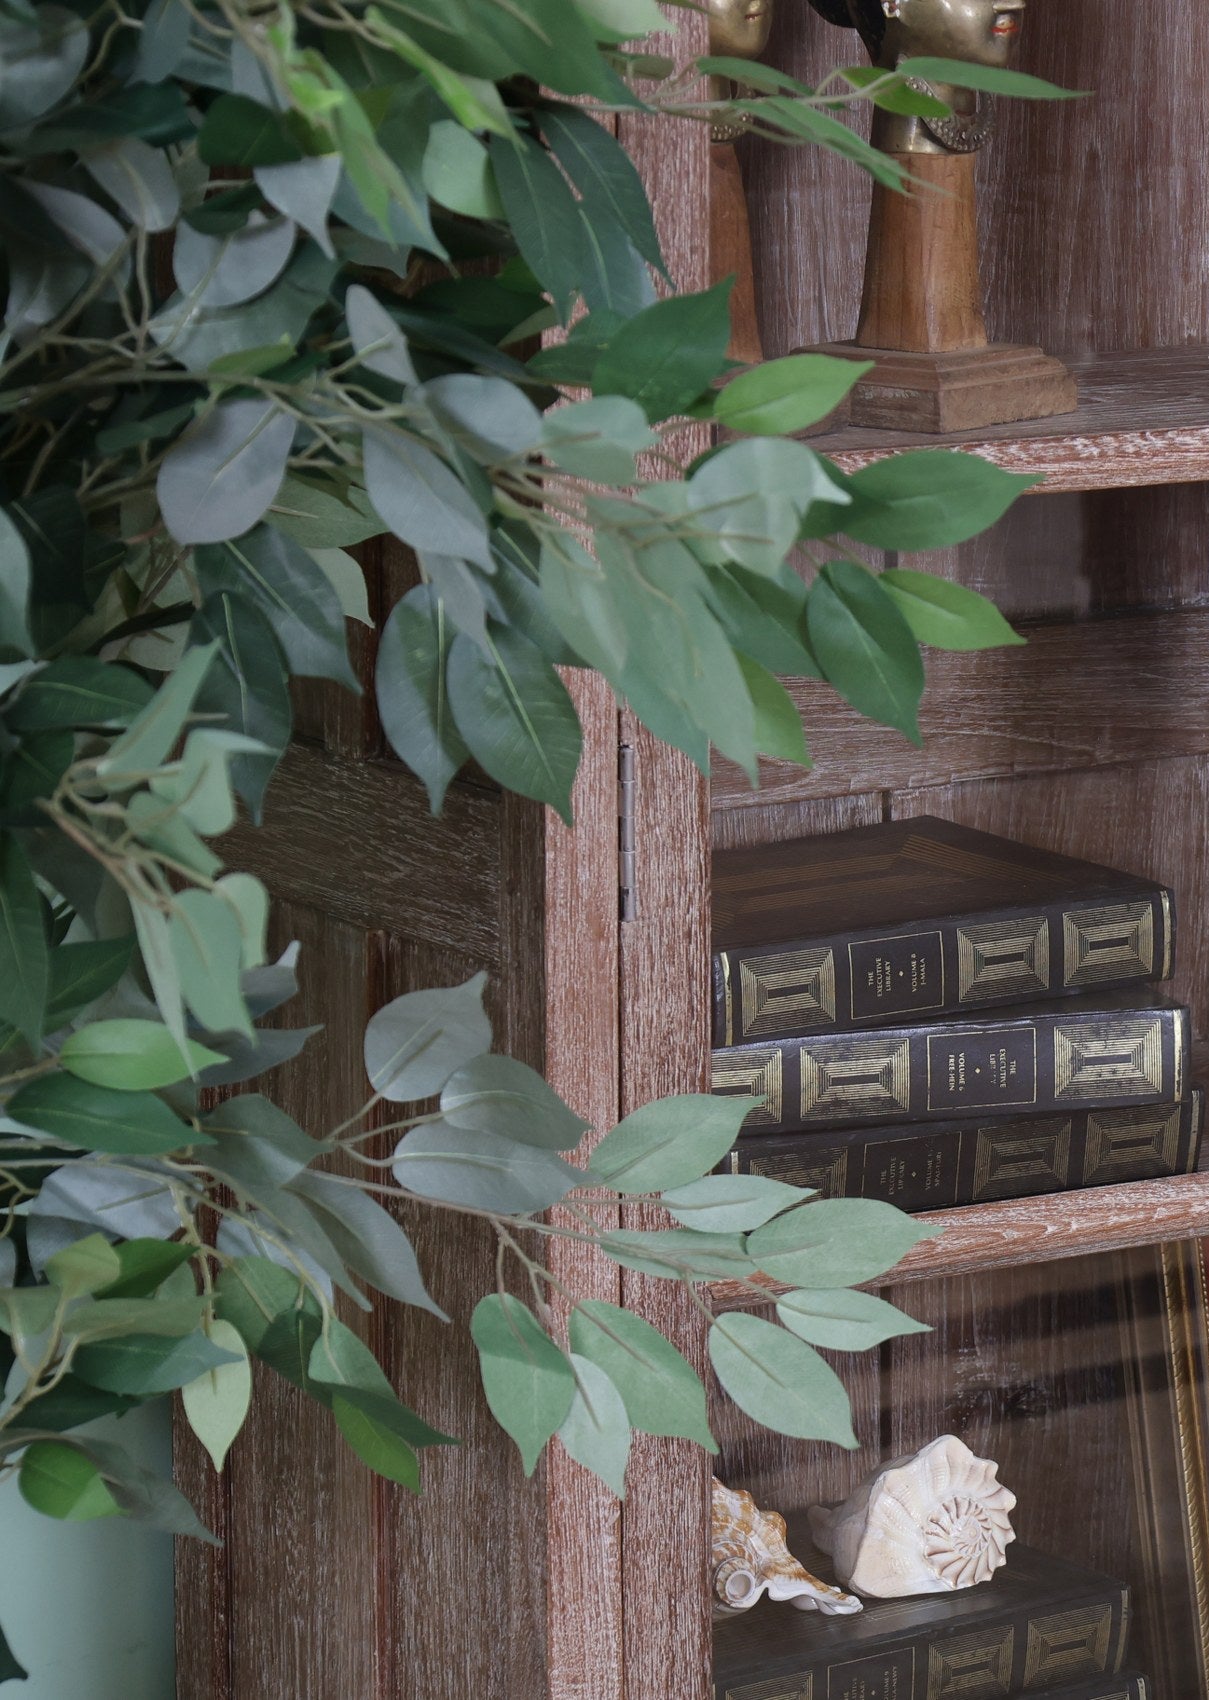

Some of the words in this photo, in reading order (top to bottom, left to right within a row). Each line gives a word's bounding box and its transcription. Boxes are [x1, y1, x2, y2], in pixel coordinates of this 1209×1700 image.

[867, 970, 875, 987] THE
[875, 957, 884, 998] EXECUTIVE
[884, 960, 892, 992] LIBRARY
[910, 960, 919, 993] VOLUME
[958, 1052, 966, 1086] VOLUME
[999, 1048, 1008, 1089] EXECUTIVE
[1009, 1059, 1018, 1076] THE
